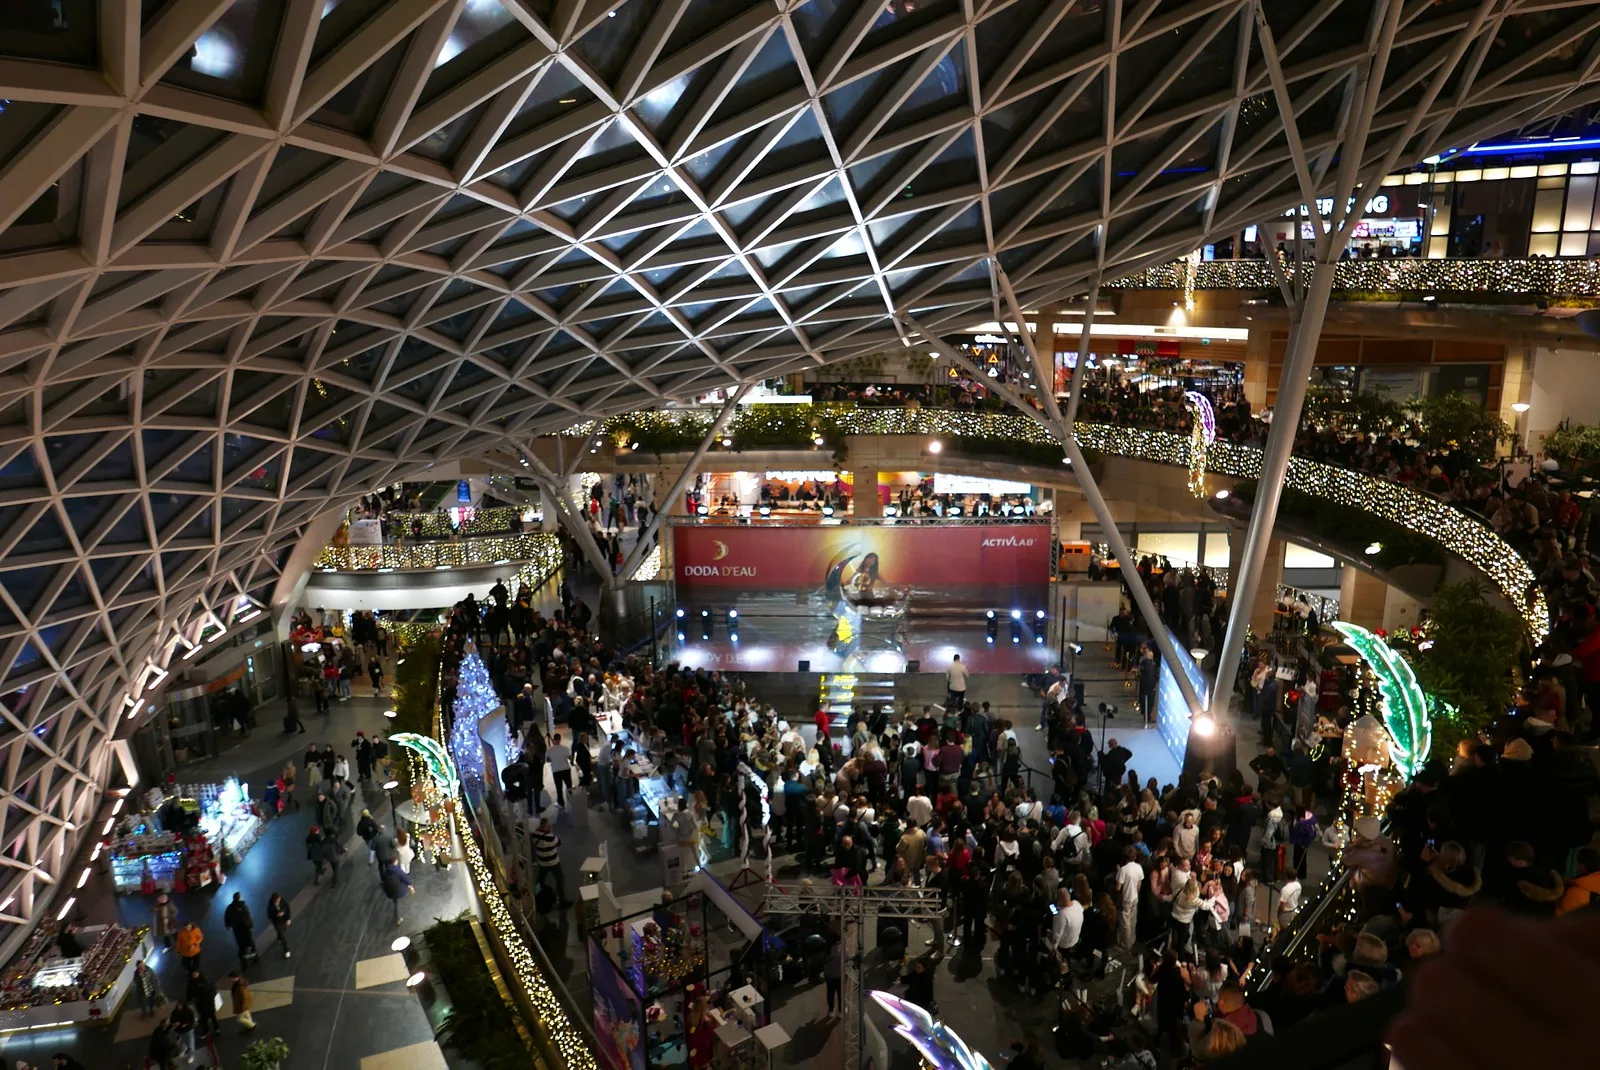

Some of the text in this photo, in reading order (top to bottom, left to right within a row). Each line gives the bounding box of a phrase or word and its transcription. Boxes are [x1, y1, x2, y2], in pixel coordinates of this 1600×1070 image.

[981, 536, 1034, 547] ACTIVLAB
[684, 566, 757, 577] DODA D'EAU
